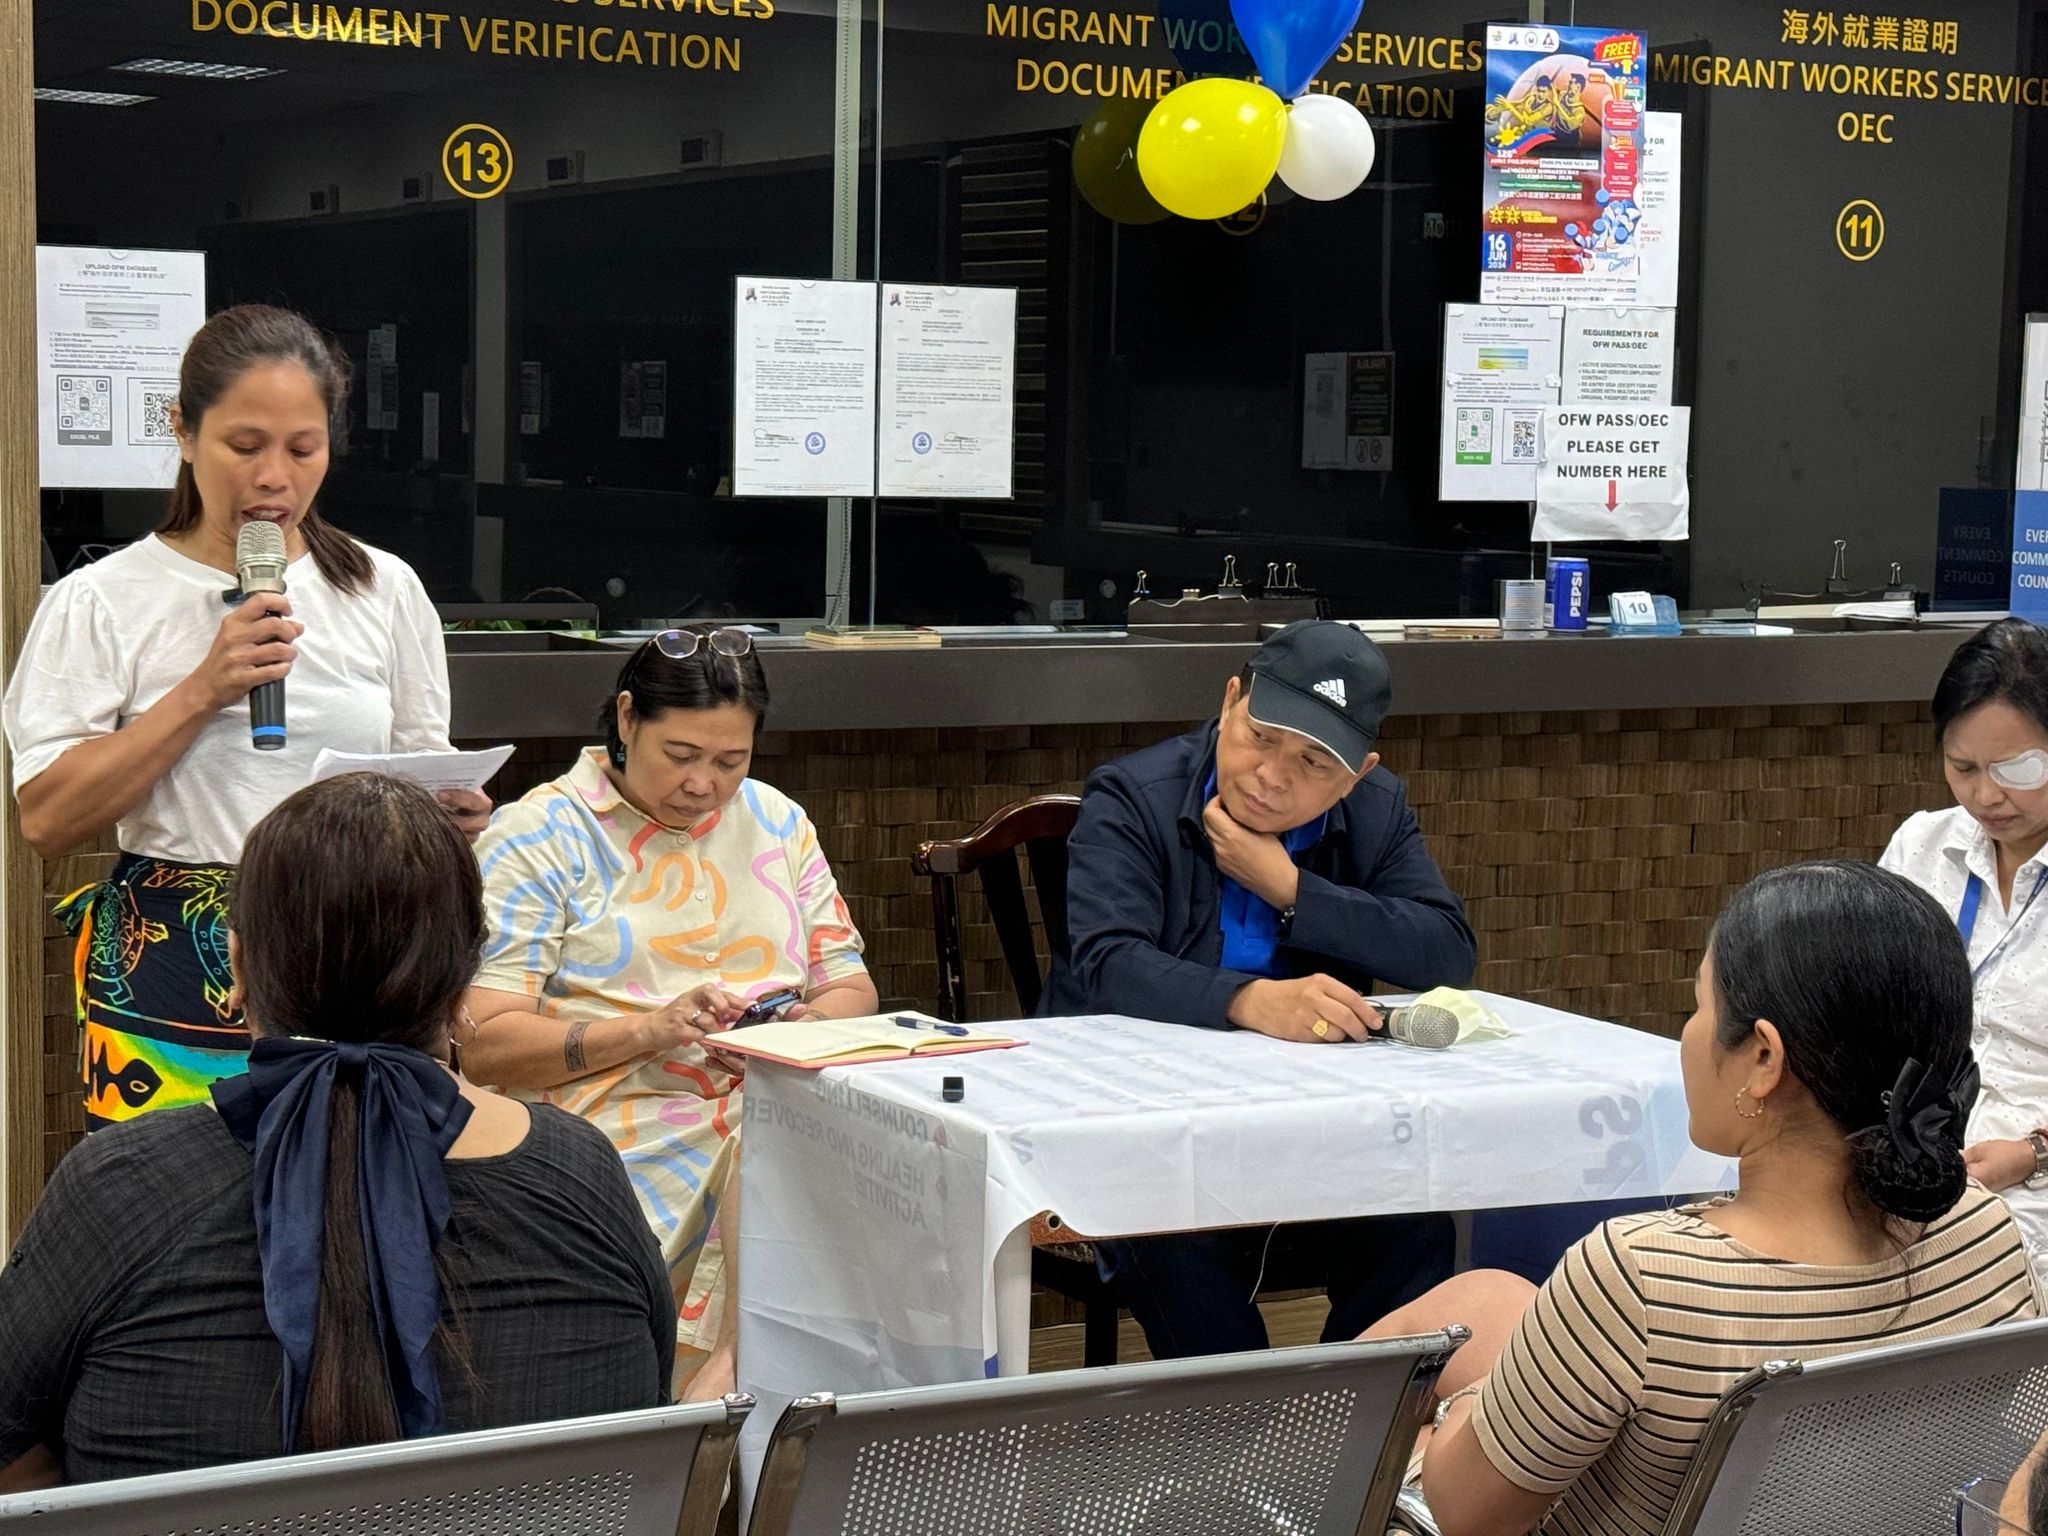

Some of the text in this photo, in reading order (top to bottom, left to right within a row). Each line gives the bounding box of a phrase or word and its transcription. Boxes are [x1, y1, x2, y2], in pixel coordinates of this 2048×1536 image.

[191, 0, 742, 72] DOCUMENT VERIFICATION
[986, 3, 1155, 48] MIGRANT
[1780, 8, 1959, 56] 海外就業證明
[1602, 39, 1637, 58] FREE!
[1653, 52, 1794, 90] MIGRANT
[1800, 62, 1939, 100] WORKERS
[1836, 111, 1894, 143] OEC
[453, 141, 502, 183] 13
[1488, 234, 1507, 251] 16
[1845, 213, 1873, 248] 11
[1487, 251, 1507, 261] JUN
[1582, 329, 1642, 338] REQUIREMENTS
[1558, 413, 1669, 427] OFW PASS/OEC
[1567, 441, 1660, 454] PLEASE GET
[1557, 465, 1667, 478] NUMBER HERE
[1569, 571, 1583, 617] PEPSI
[1628, 602, 1649, 615] 10
